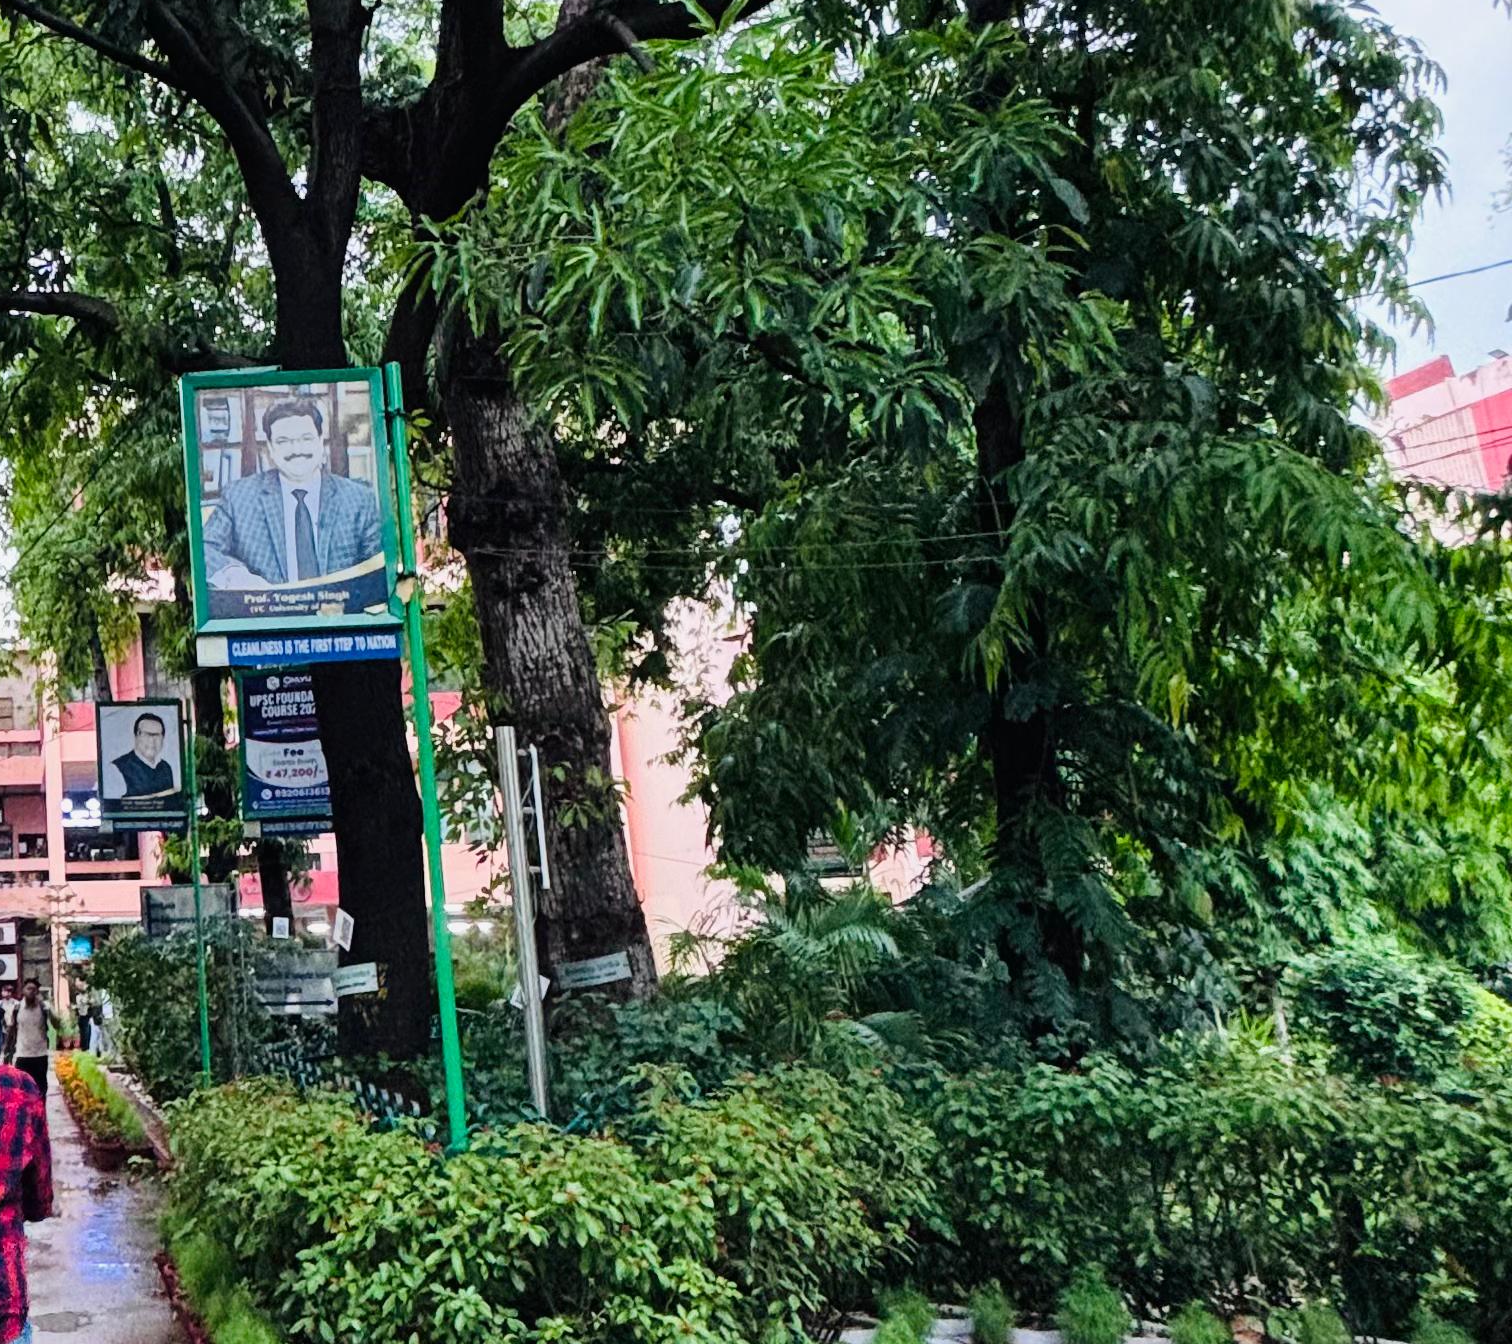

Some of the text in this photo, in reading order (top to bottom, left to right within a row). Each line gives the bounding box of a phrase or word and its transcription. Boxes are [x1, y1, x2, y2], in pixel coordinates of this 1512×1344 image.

[244, 589, 350, 605] Prof. Yogesh Singh
[269, 603, 308, 614] University
[232, 634, 397, 657] CLEANLINESS IS THE FIRST STEP TO NATION
[249, 693, 275, 708] UPSC
[261, 703, 299, 719] COURSE
[283, 747, 304, 757] Fee
